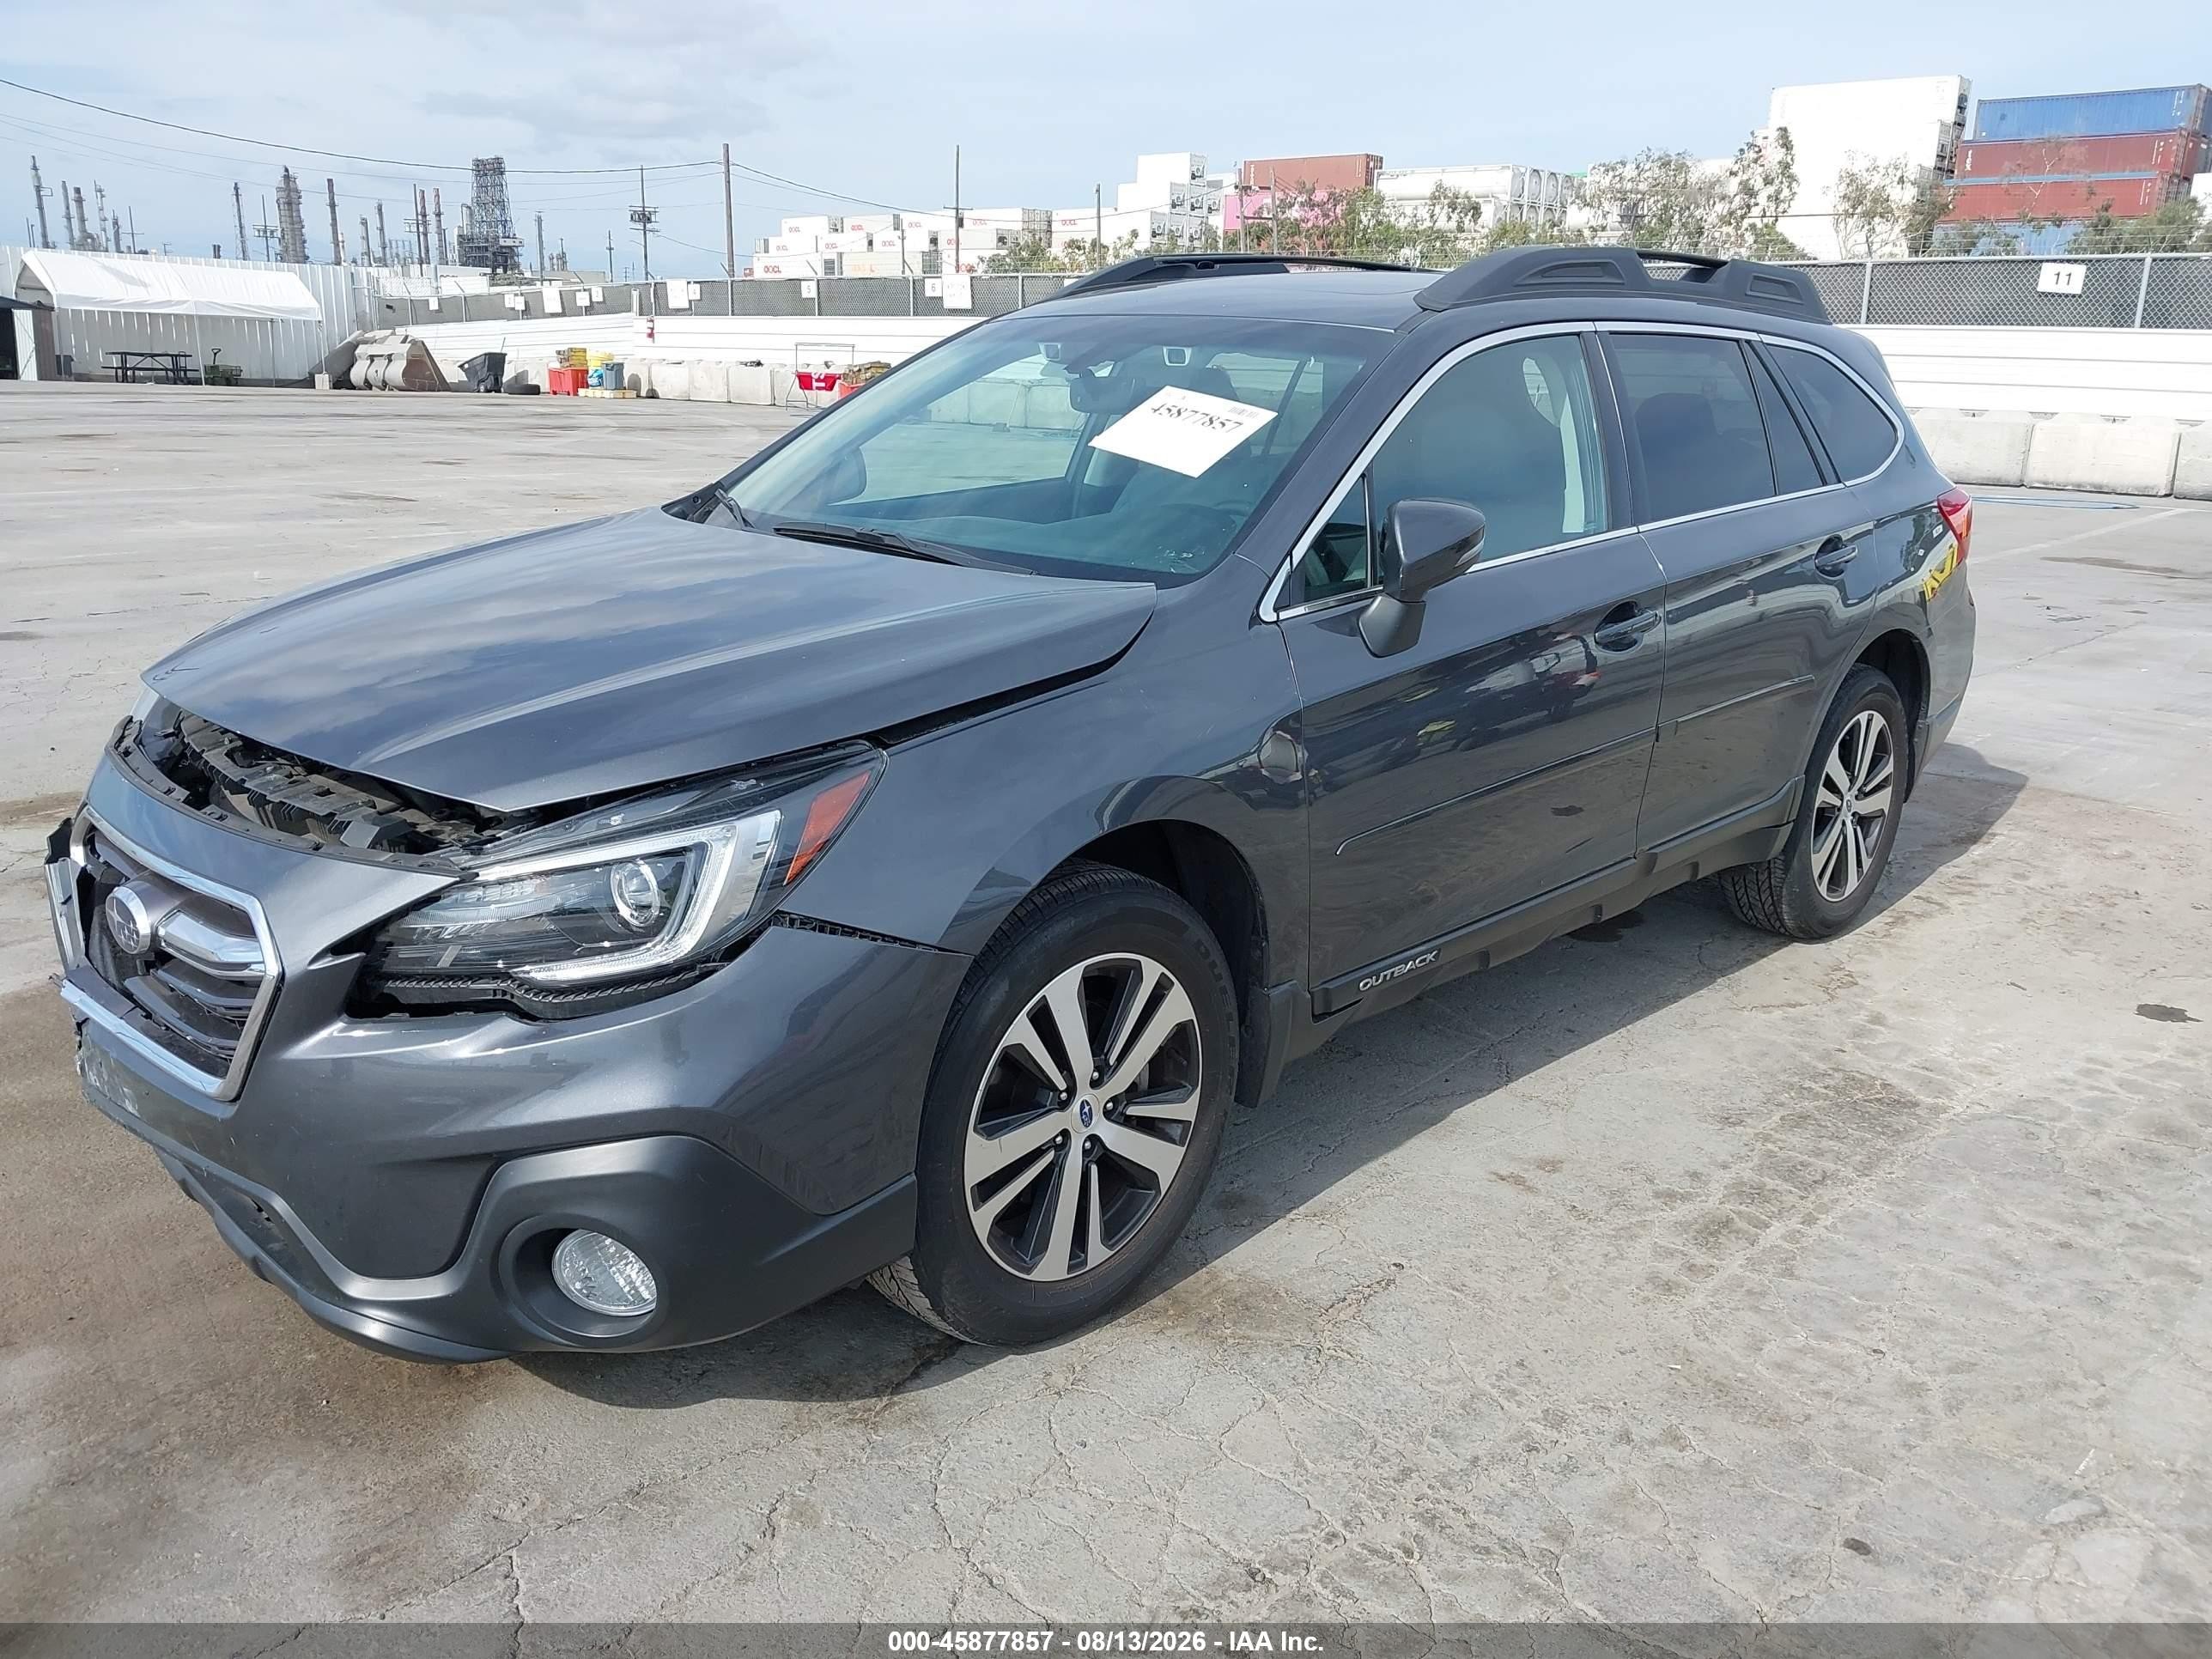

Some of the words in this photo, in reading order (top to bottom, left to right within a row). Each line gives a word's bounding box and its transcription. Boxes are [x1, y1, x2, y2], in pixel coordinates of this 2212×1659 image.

[763, 264, 781, 274] OOCL
[2053, 271, 2072, 286] 11
[1151, 403, 1243, 434] 45877857
[1359, 950, 1437, 992] OUTBACK
